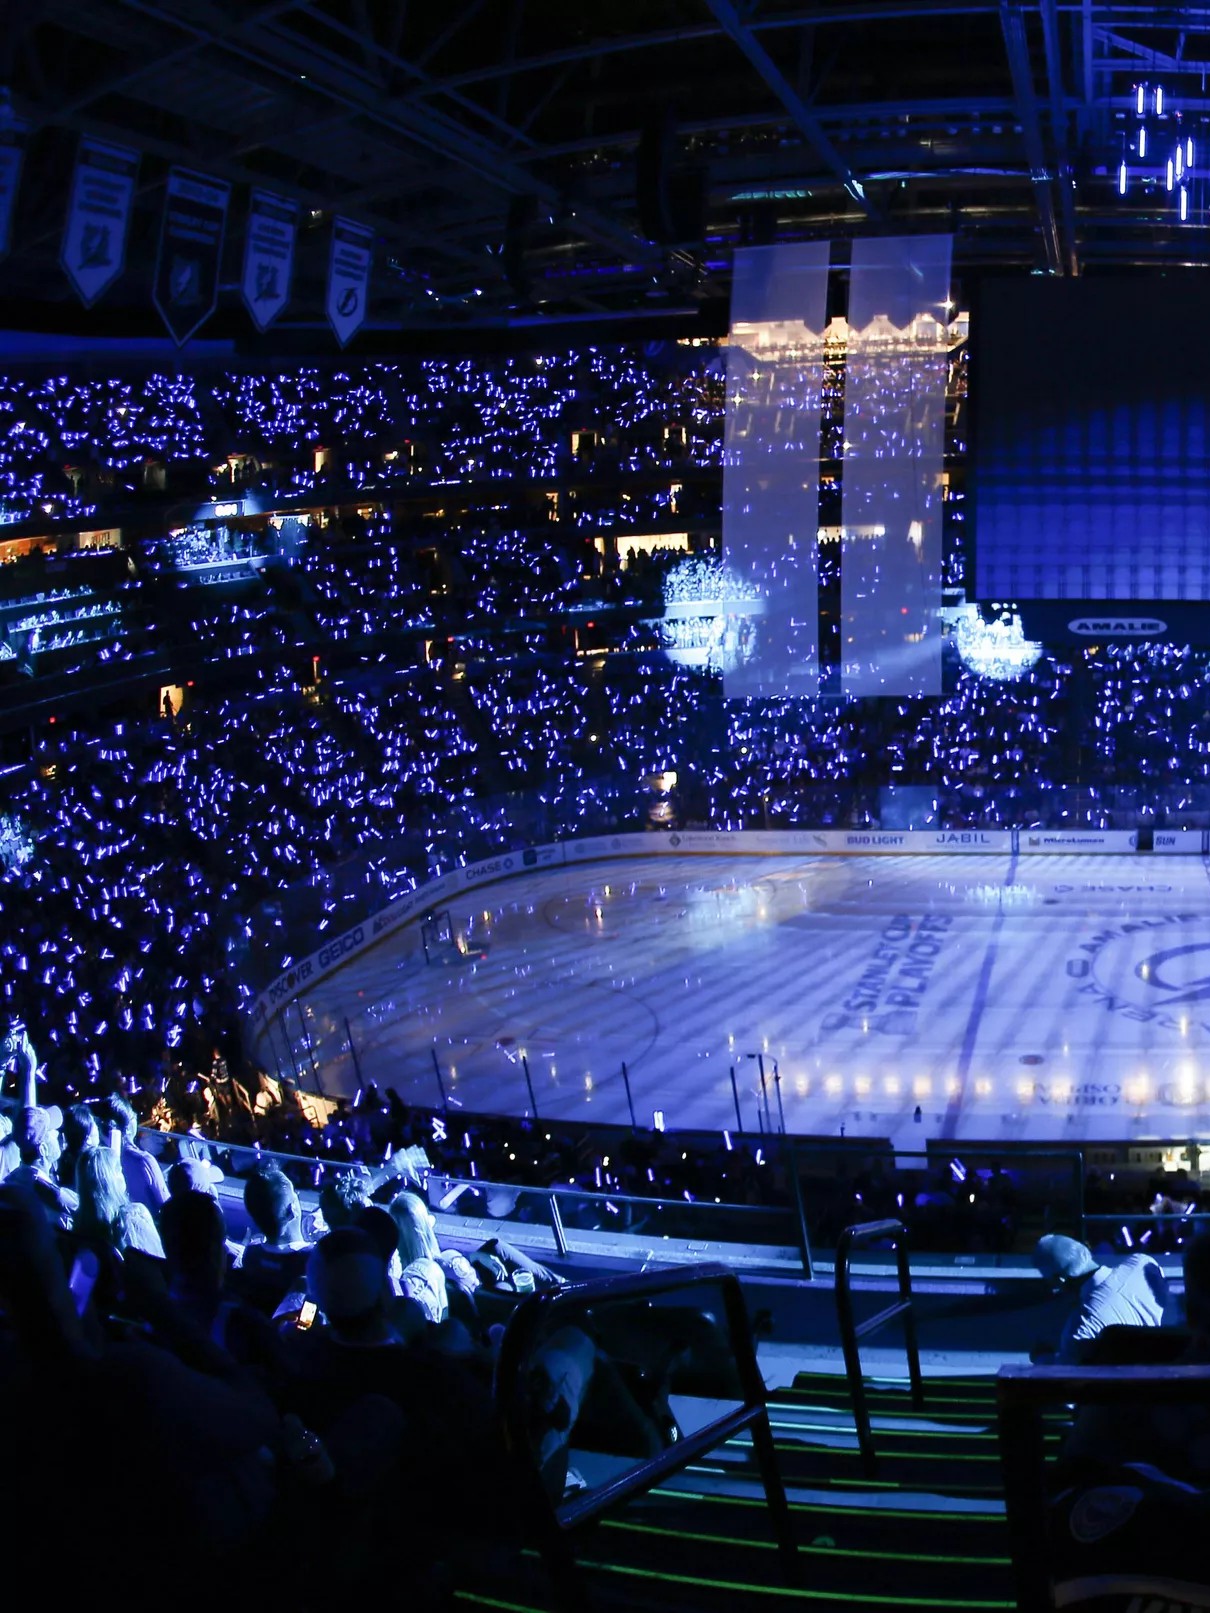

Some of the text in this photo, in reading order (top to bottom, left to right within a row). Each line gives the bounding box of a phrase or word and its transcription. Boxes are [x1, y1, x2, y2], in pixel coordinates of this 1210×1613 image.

[1076, 622, 1160, 631] AMALIE
[847, 836, 904, 845] BUD LIGHT
[936, 833, 990, 844] JABIL
[1155, 836, 1175, 847] SUN
[466, 862, 501, 880] CHASE
[318, 926, 366, 969] GEICO
[884, 912, 954, 1008] PLAYOFFS
[843, 938, 902, 1013] STANLEY
